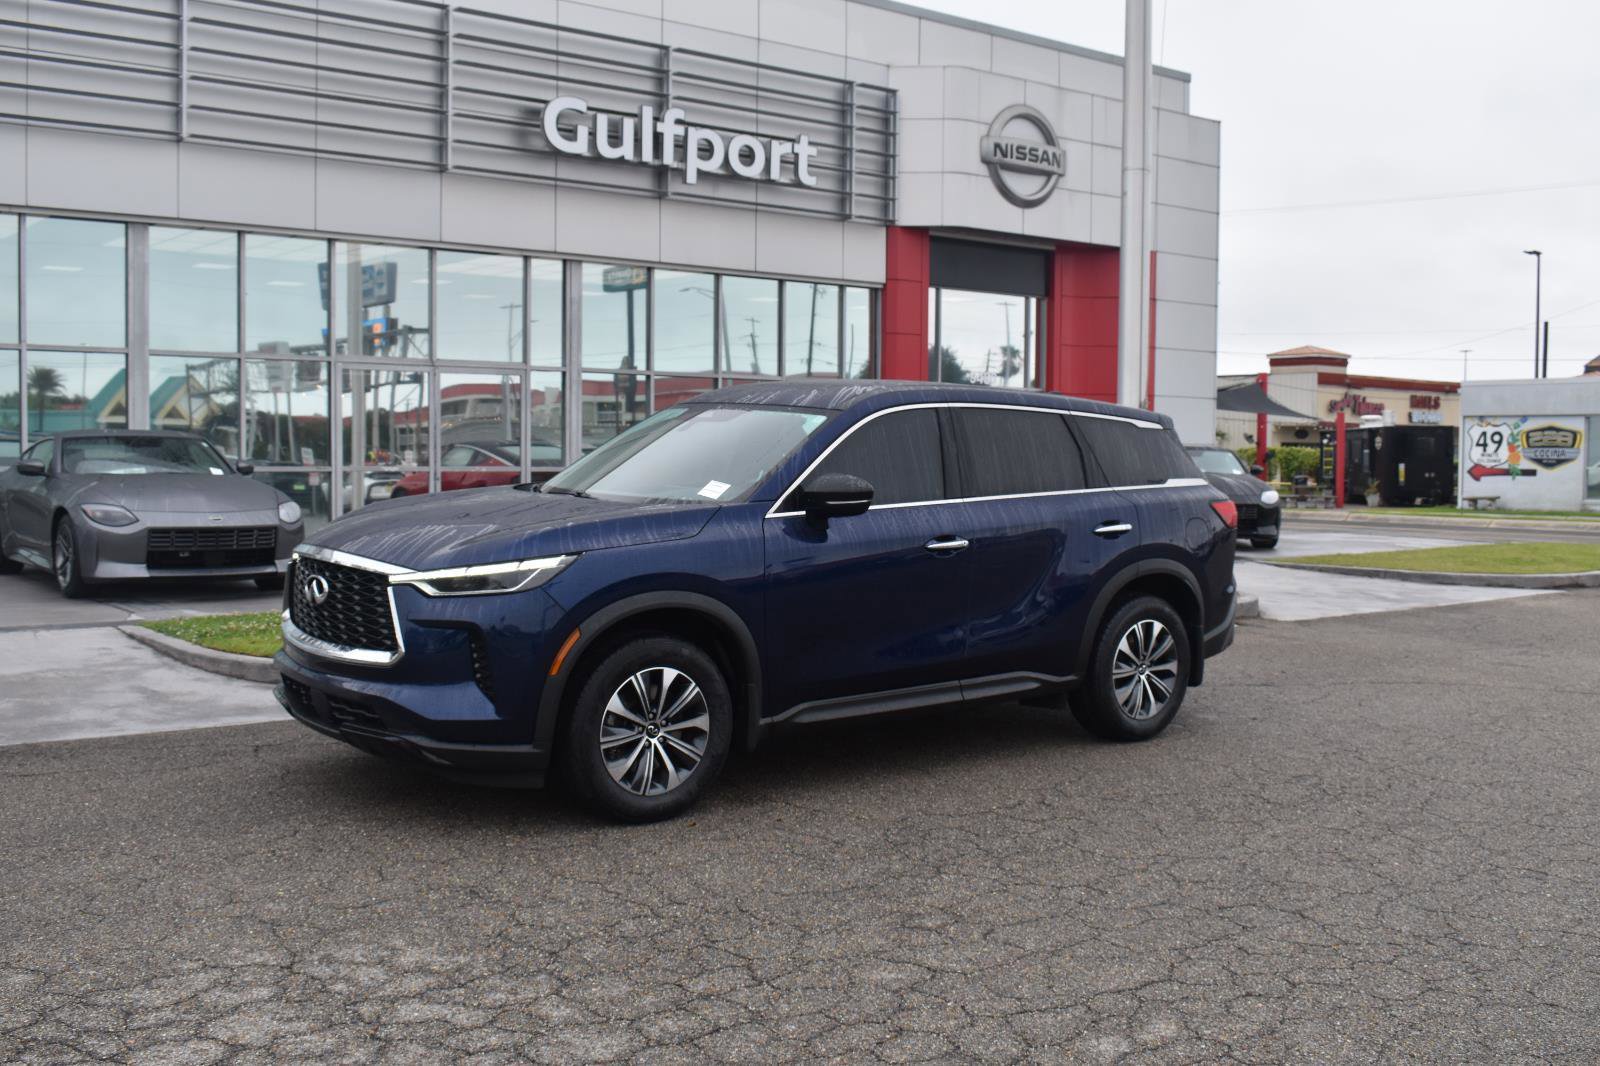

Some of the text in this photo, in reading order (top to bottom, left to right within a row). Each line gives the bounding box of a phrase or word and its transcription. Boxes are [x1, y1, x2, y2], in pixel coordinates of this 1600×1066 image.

[542, 96, 818, 185] Gulfport
[993, 142, 1062, 169] NISSAN
[1475, 431, 1504, 453] 49
[1534, 448, 1567, 458] COCINA
